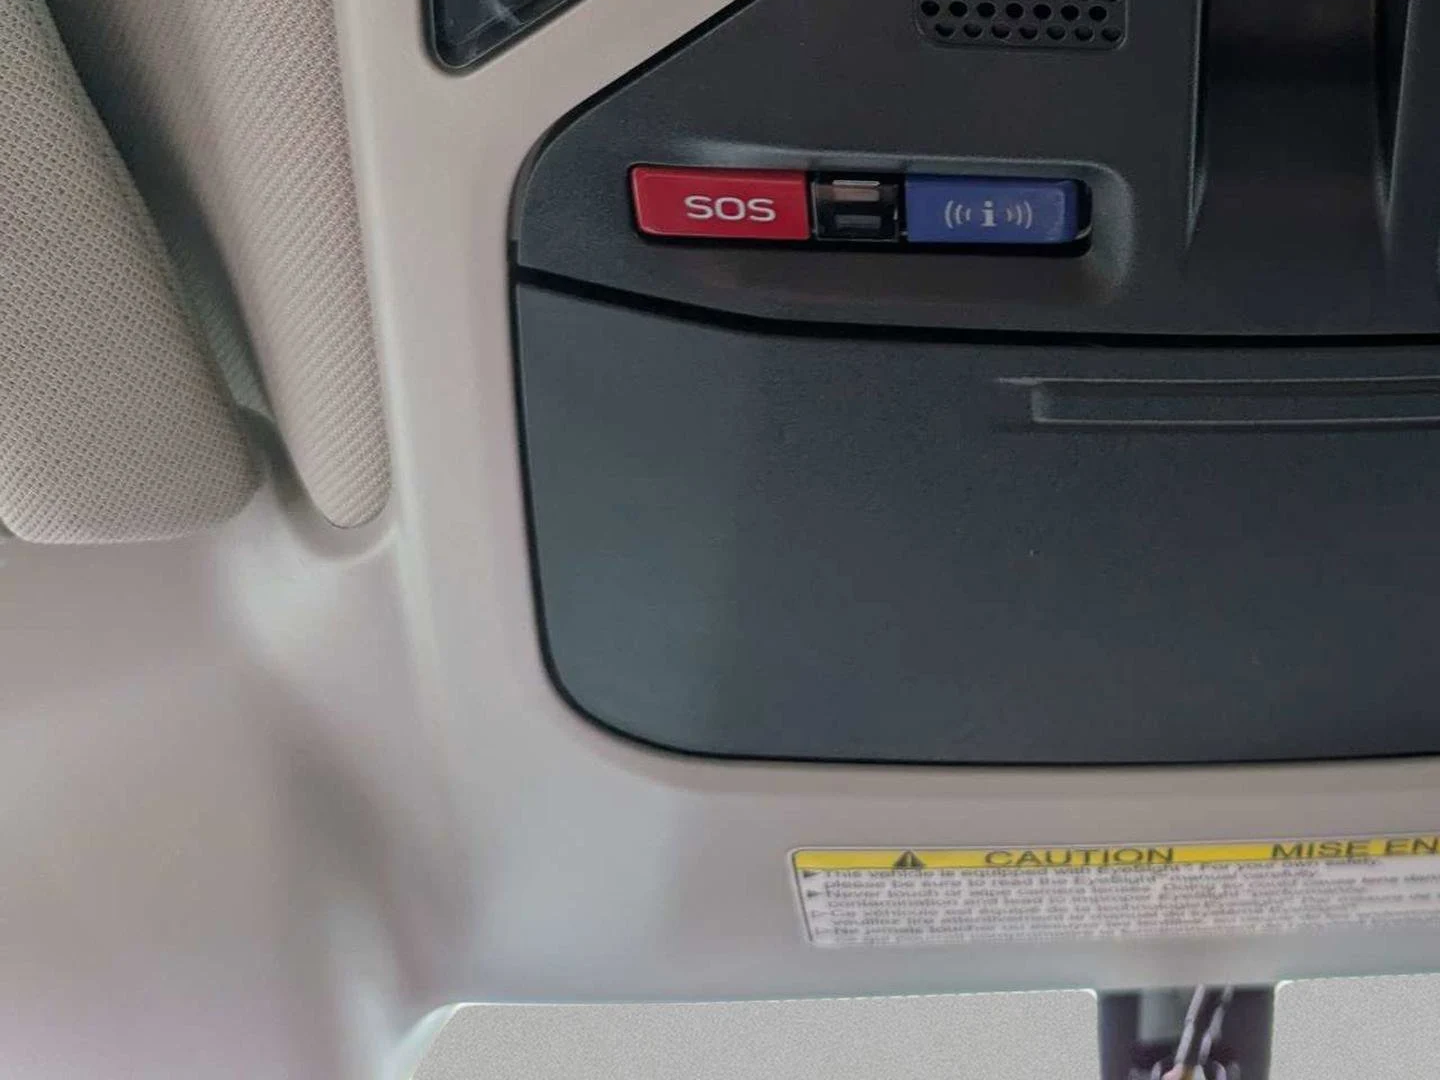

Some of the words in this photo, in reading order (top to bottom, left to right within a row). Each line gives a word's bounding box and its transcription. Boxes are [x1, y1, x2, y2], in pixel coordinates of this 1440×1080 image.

[684, 194, 776, 221] SOS
[985, 848, 1174, 867] CAUTION
[1271, 841, 1370, 861] MISE
[1383, 835, 1439, 856] EN
